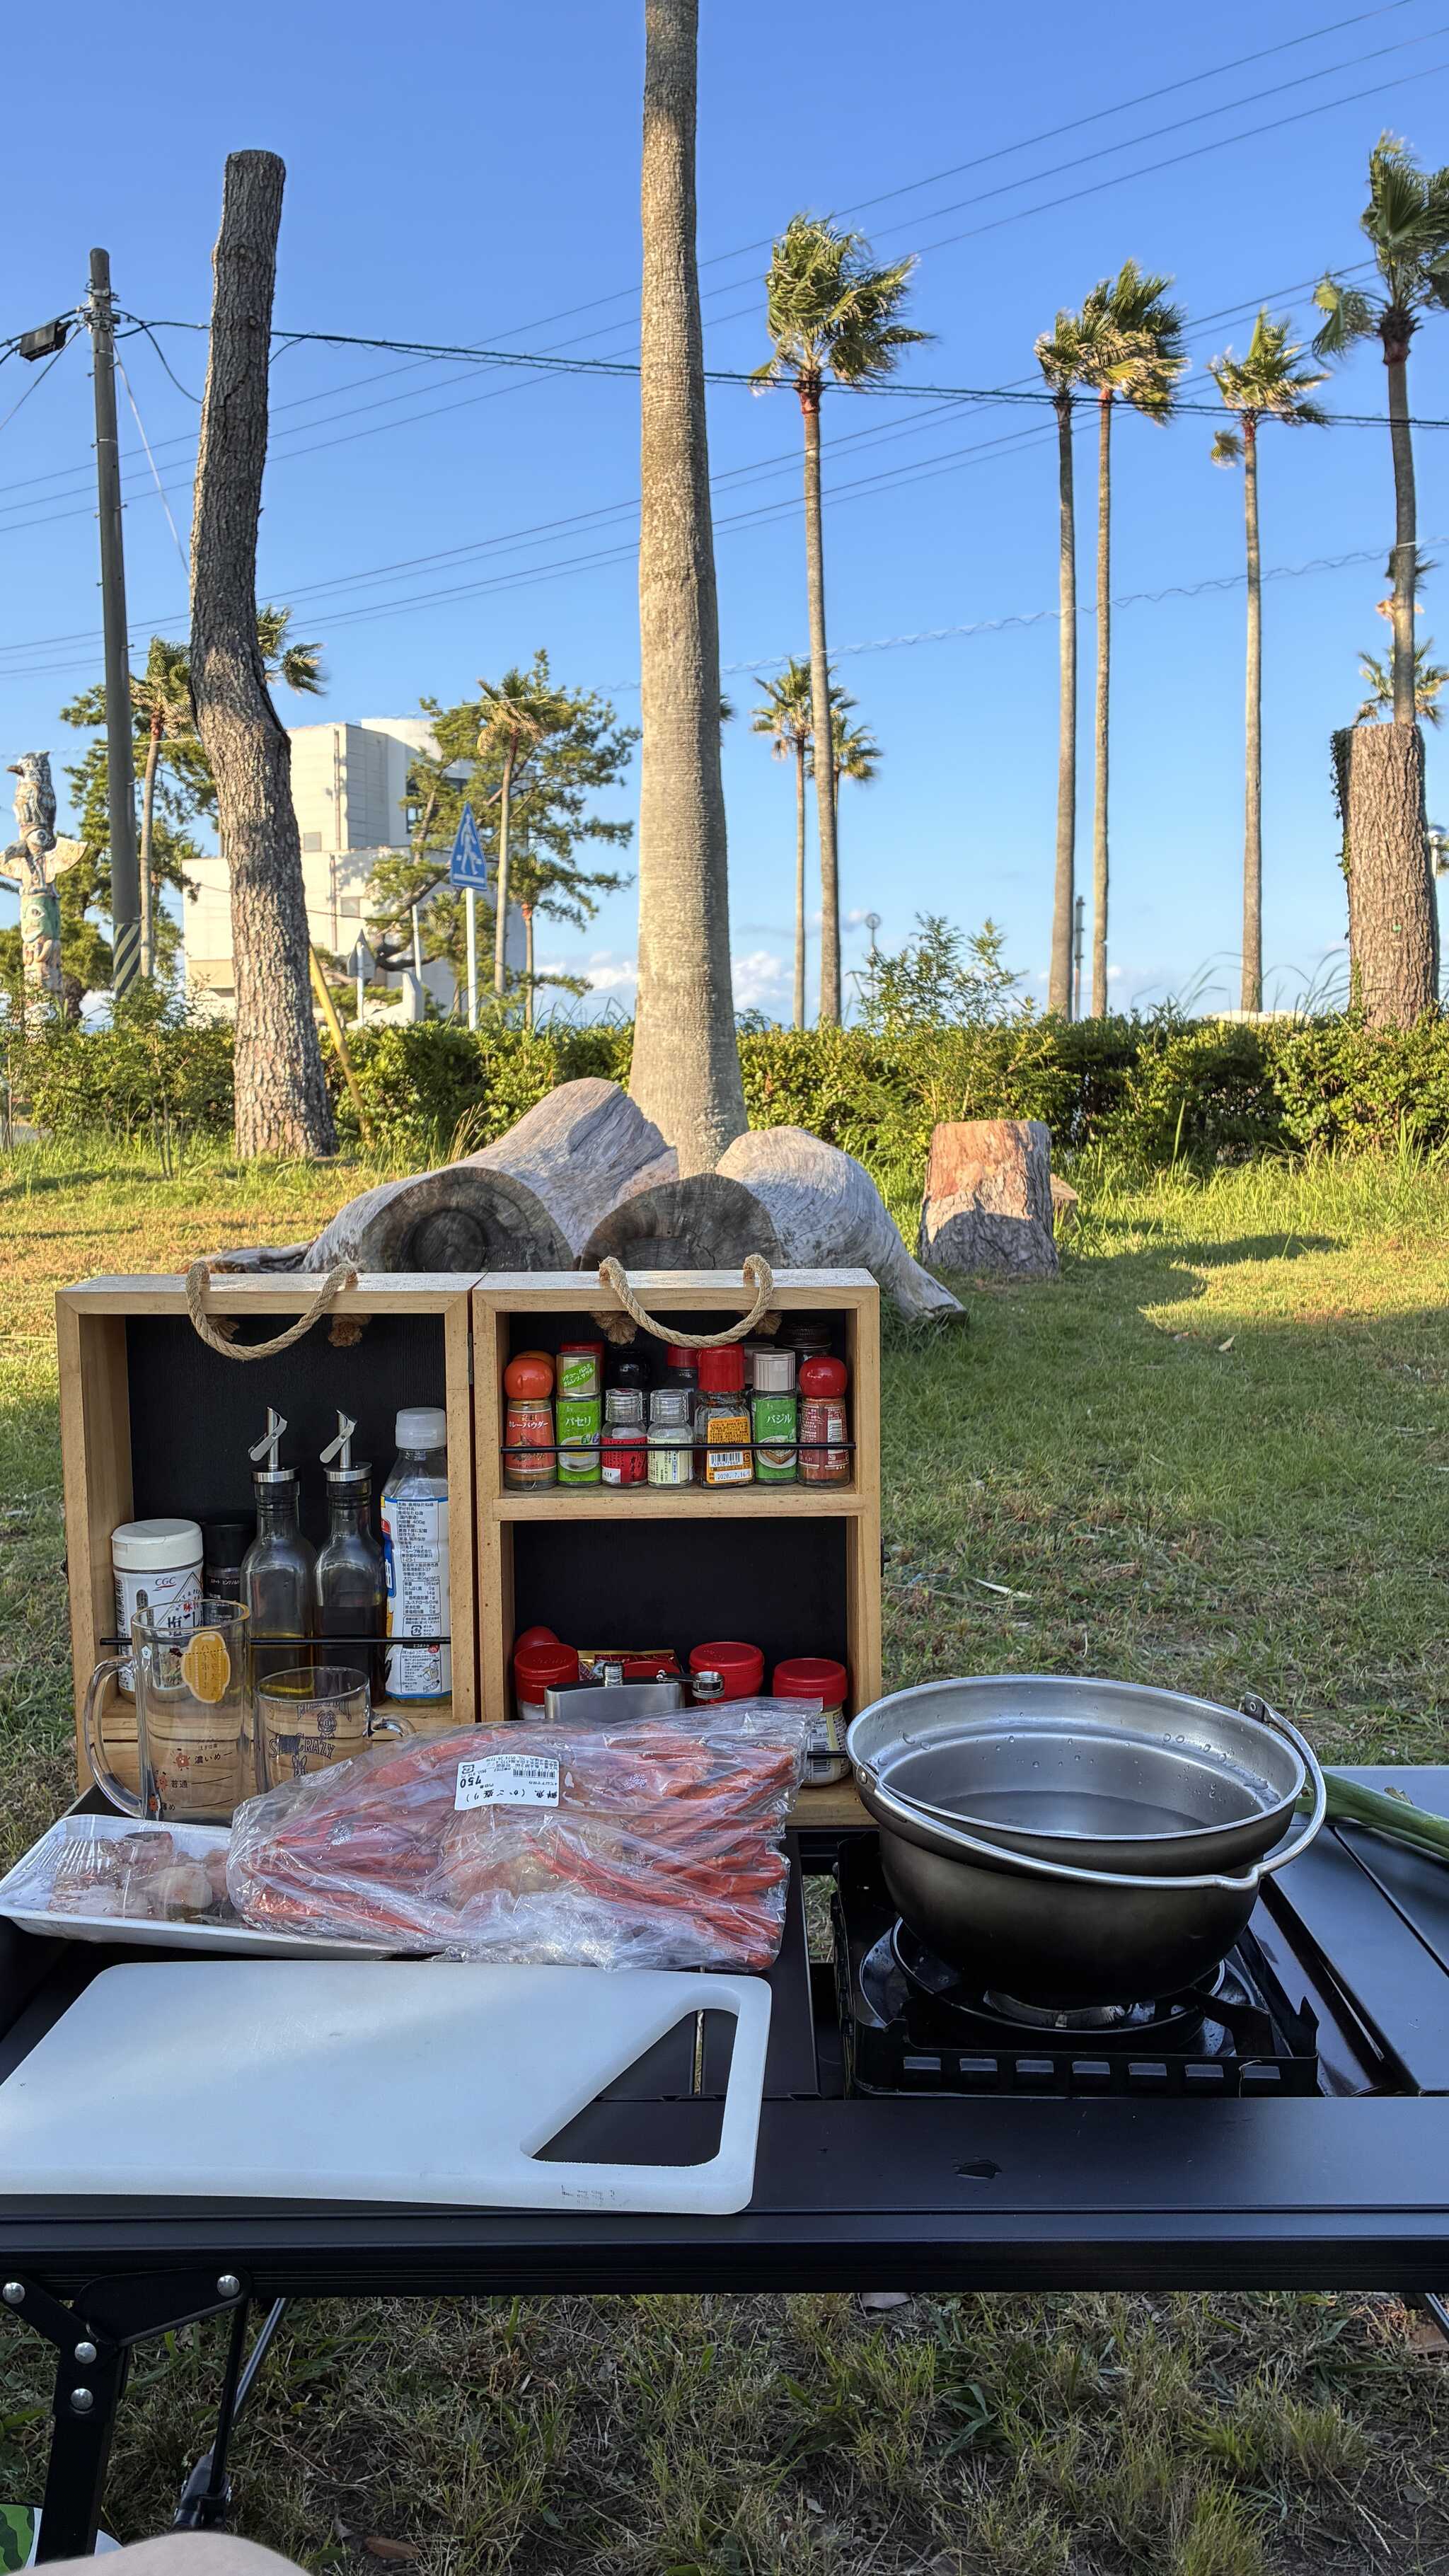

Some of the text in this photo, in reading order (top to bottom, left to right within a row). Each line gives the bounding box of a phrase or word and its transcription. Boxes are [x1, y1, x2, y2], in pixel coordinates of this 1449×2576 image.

[566, 1416, 591, 1427] パセリ
[766, 1413, 792, 1424] バジル
[508, 1421, 549, 1430] カレーパウダー
[155, 1576, 177, 1586] CGC
[195, 1754, 221, 1764] 濃いめ
[171, 1779, 188, 1789] 普通
[460, 1775, 482, 1788] 750
